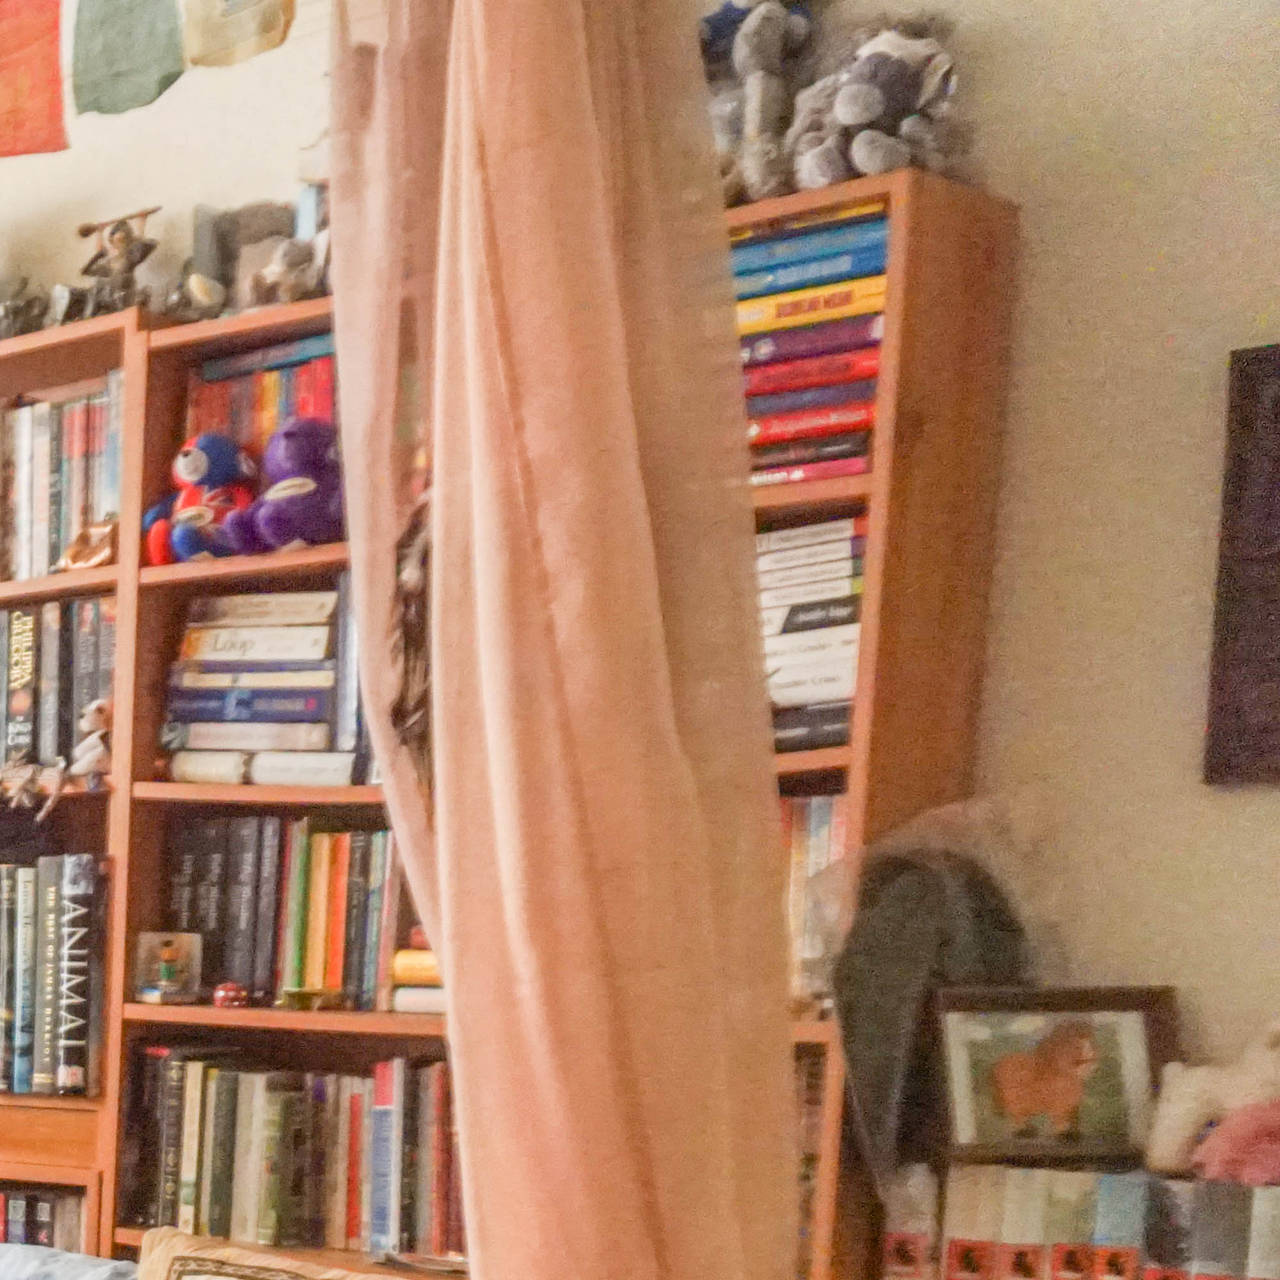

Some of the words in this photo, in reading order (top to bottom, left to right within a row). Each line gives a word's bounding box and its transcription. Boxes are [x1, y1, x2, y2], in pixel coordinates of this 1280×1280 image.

[9, 611, 24, 690] GREGORY
[21, 615, 34, 684] PHILIPPA
[47, 886, 57, 907] THE
[46, 914, 56, 938] BEST
[45, 945, 55, 959] OF
[44, 963, 55, 1000] JAMES
[58, 899, 89, 1057] ANIMAL
